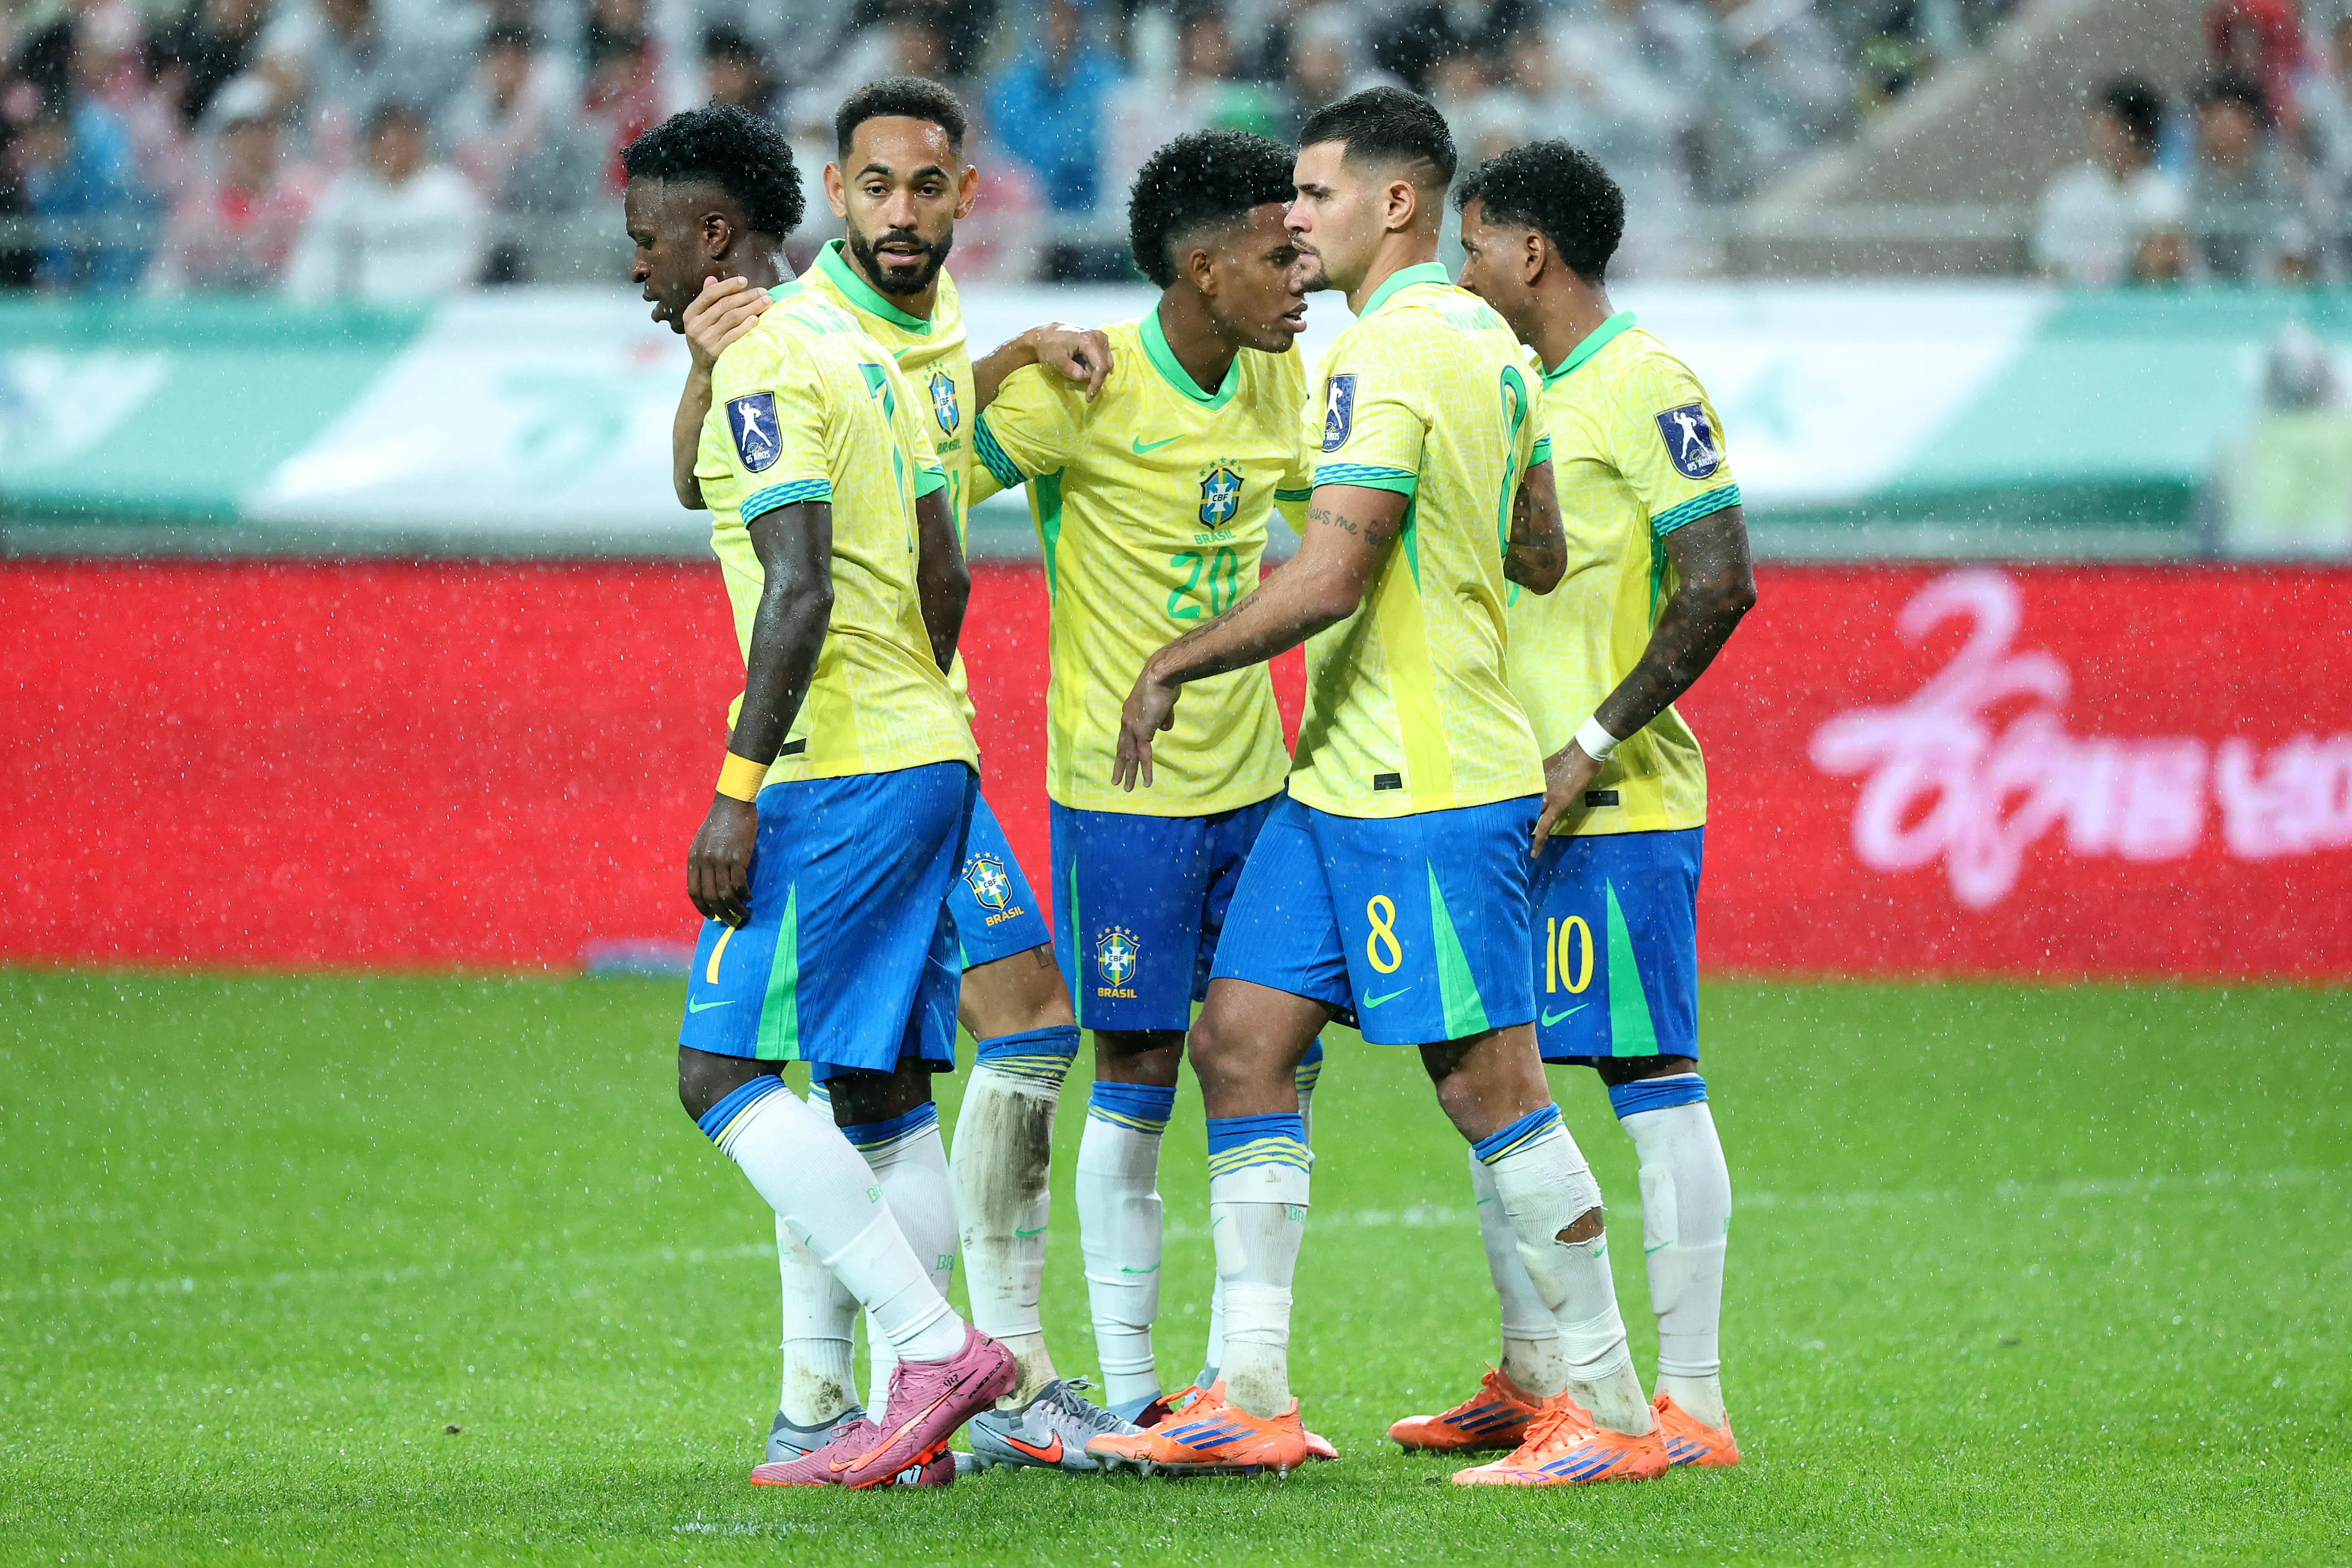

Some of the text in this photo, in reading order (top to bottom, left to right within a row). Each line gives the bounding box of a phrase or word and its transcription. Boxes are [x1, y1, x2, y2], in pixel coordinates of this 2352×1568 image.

[940, 397, 949, 406] CBF
[1326, 432, 1340, 441] ANOS
[937, 438, 962, 454] BRASIL
[746, 450, 771, 464] 85 ANOS
[1687, 456, 1714, 472] 85 ANOS
[1212, 493, 1229, 502] CBF
[1334, 515, 1358, 535] me
[1194, 529, 1237, 545] BRASIL
[1167, 546, 1238, 619] 20
[984, 878, 997, 888] CBF
[985, 906, 1025, 926] BRASIL
[1367, 894, 1403, 974] 8
[706, 909, 742, 985] 7
[1546, 915, 1594, 994] 10
[1097, 988, 1137, 998] BRASIL
